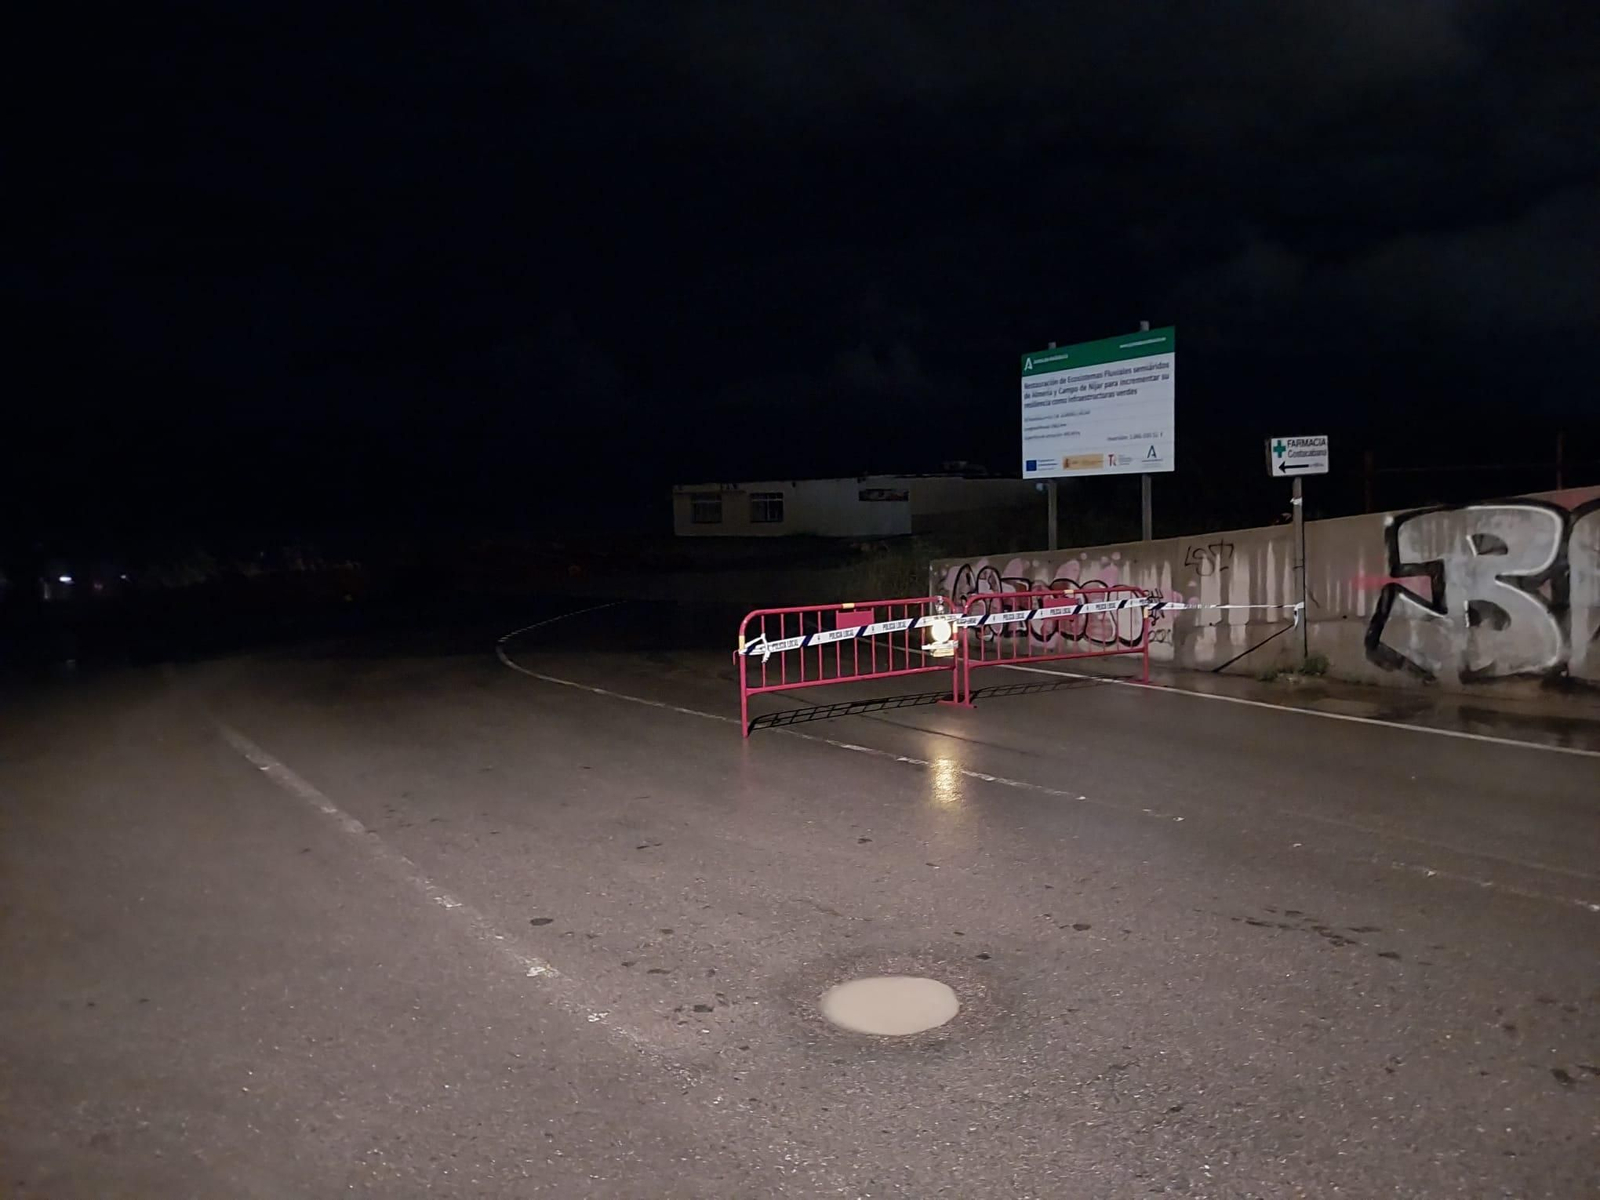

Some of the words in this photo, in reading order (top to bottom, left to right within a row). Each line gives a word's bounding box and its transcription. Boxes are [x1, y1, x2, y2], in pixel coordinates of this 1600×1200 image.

[1104, 368, 1132, 377] Fluviales
[1058, 387, 1079, 395] Campo
[1104, 381, 1118, 389] para
[1120, 375, 1160, 385] incrementar
[1068, 392, 1115, 403] infraestructuras
[1287, 438, 1326, 448] FARMACIA
